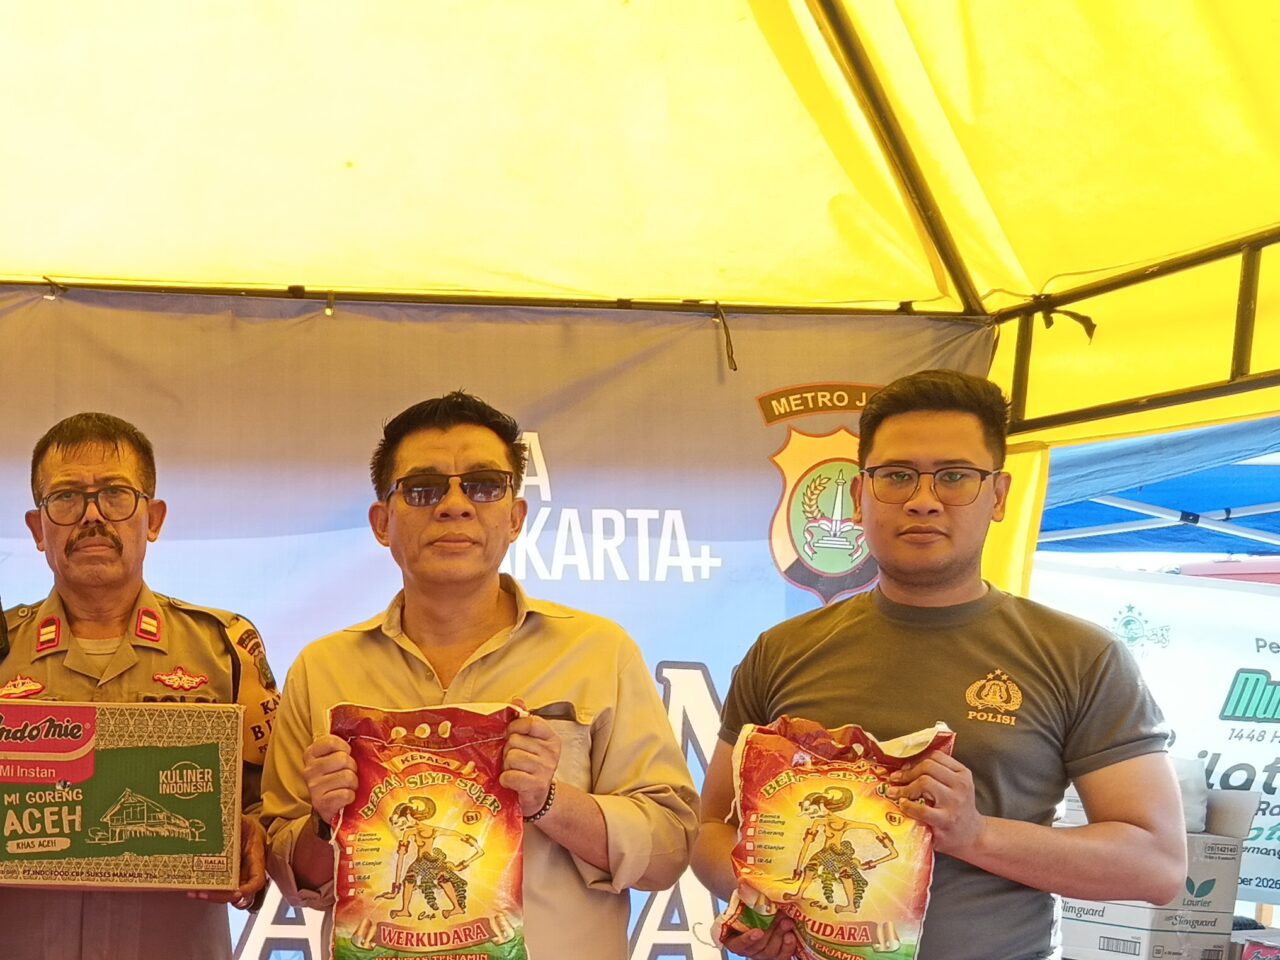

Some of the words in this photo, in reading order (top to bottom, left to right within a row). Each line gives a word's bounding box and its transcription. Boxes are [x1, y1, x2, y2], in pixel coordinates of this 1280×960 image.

[771, 390, 850, 416] METRO
[967, 710, 1017, 727] POLISI
[1227, 728, 1267, 743] 1448
[0, 765, 14, 778] Mi
[17, 765, 56, 779] Instan
[159, 768, 213, 784] KULINER
[159, 782, 214, 795] INDONESIA
[406, 772, 453, 790] SLYP
[4, 793, 20, 806] MI
[26, 788, 83, 804] GORENG
[3, 805, 83, 837] ACEH
[15, 840, 36, 850] KHAS
[37, 838, 57, 849] ACEH
[1182, 897, 1212, 908] Laurier
[379, 924, 489, 950] WERKUDARA
